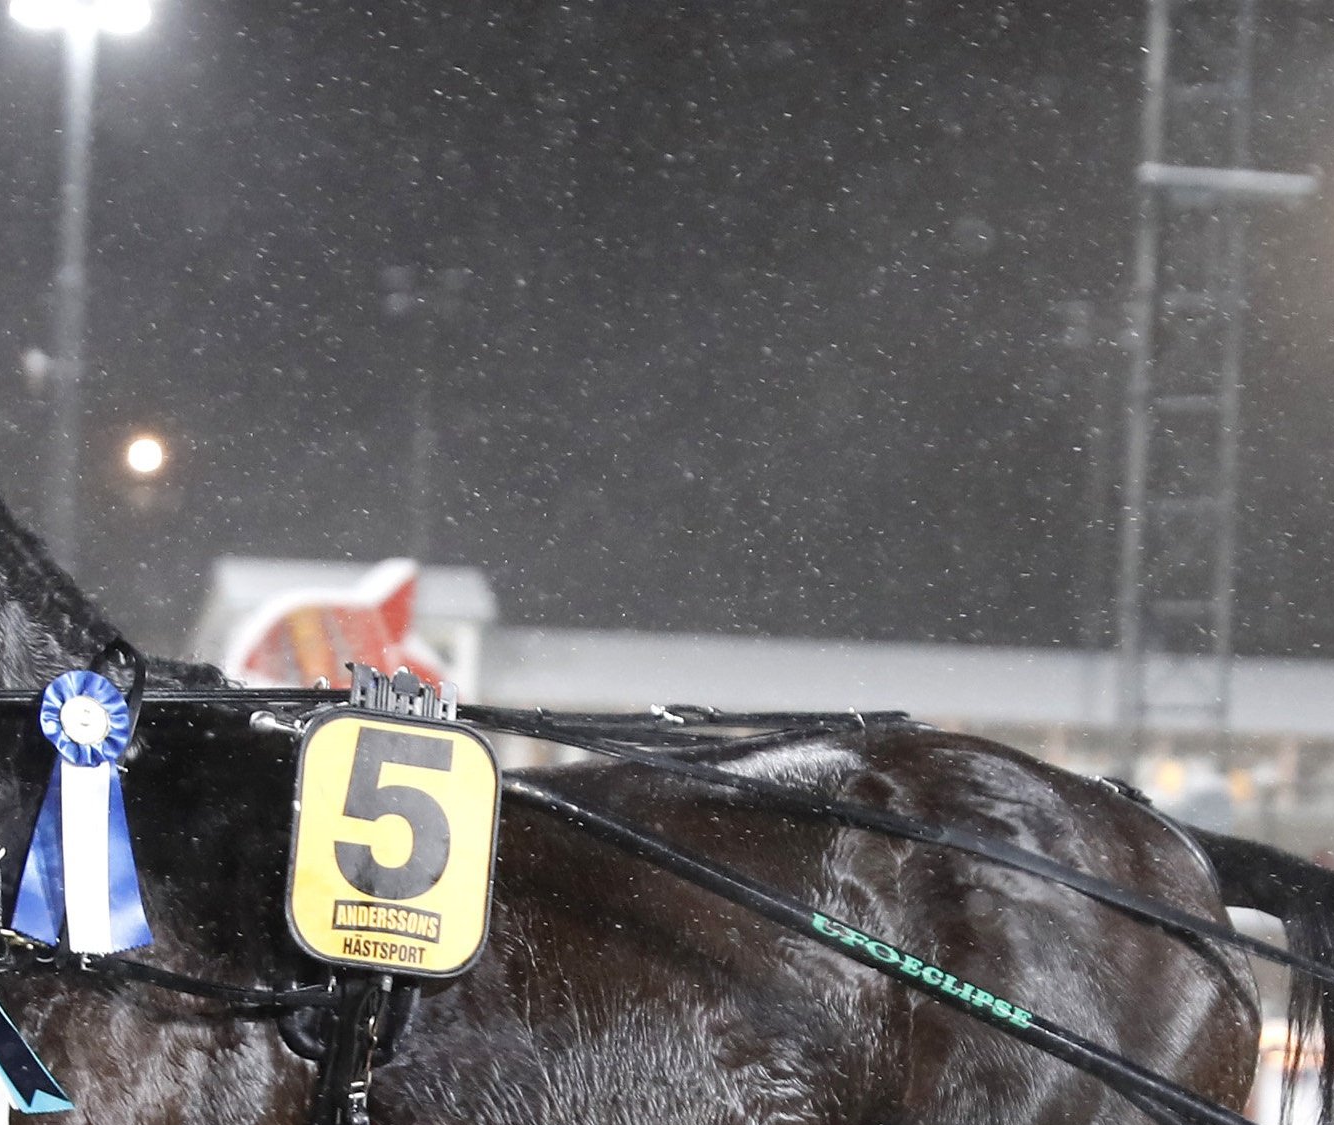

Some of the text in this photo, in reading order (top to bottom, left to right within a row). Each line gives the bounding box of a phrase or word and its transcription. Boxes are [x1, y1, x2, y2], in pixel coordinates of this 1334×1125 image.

[334, 726, 453, 900] 5
[335, 904, 440, 940] ANDERSSONS
[342, 934, 426, 964] HÄSTSPORT
